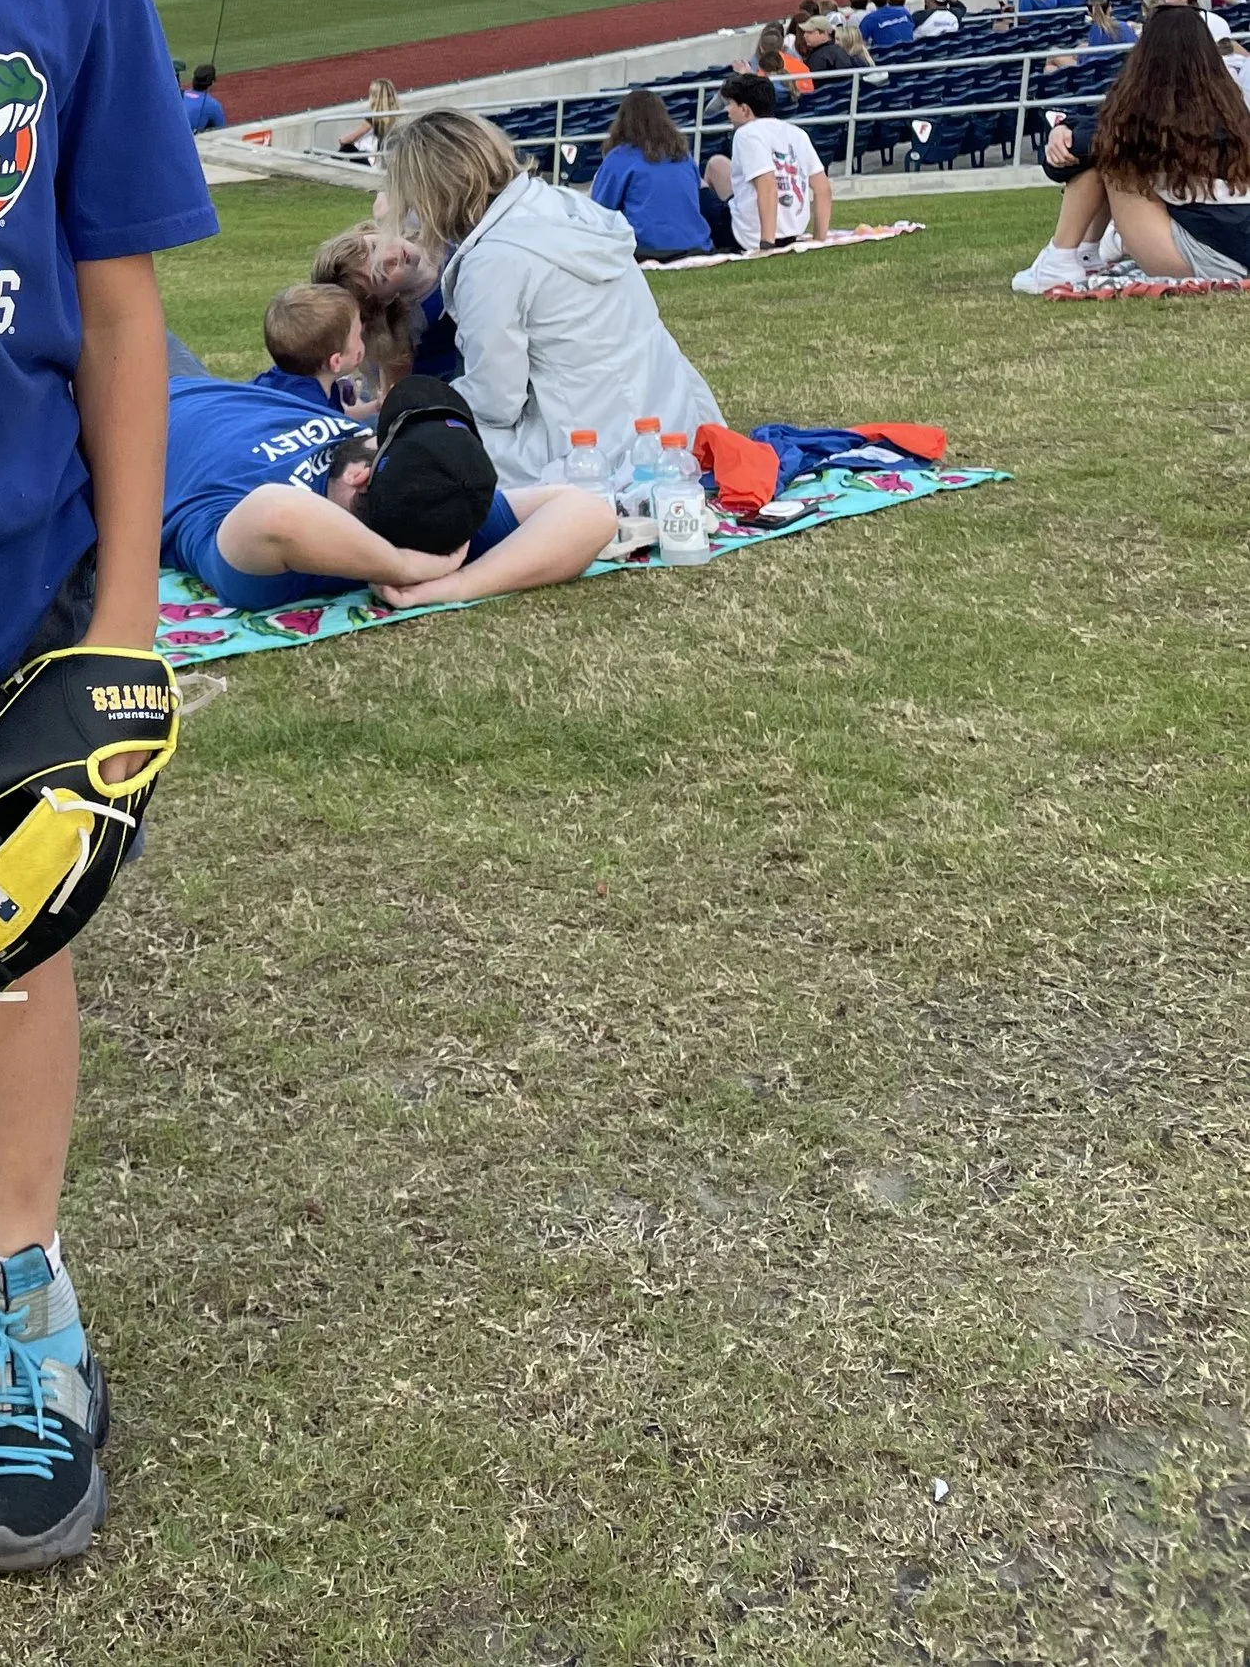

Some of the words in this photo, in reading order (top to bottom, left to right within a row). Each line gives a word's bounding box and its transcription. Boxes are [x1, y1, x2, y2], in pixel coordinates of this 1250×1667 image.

[662, 518, 699, 534] ZERO
[91, 684, 169, 713] PIRATES
[108, 711, 165, 721] PITTSBURGH
